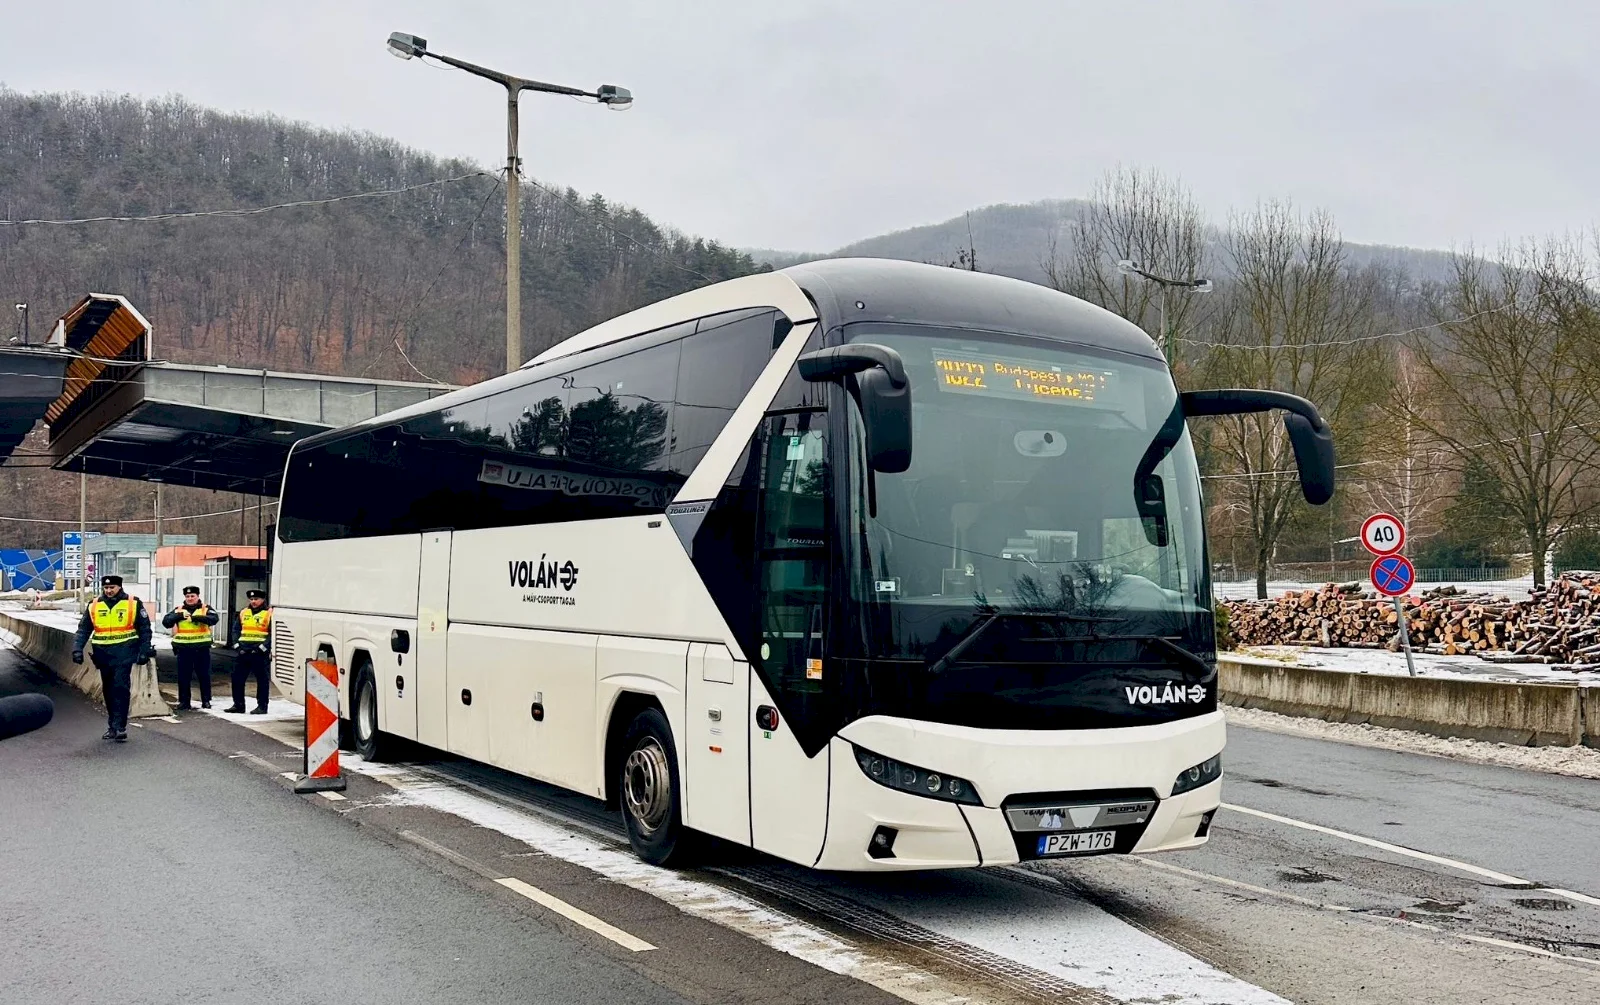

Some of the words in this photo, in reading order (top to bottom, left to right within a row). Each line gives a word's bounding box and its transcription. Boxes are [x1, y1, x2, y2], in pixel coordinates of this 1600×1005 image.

[994, 362, 1061, 384] Budapest
[1374, 526, 1394, 543] 40
[508, 553, 558, 588] VOLÁN
[1125, 681, 1186, 704] VOLÁN
[1048, 832, 1112, 852] PZW-176
